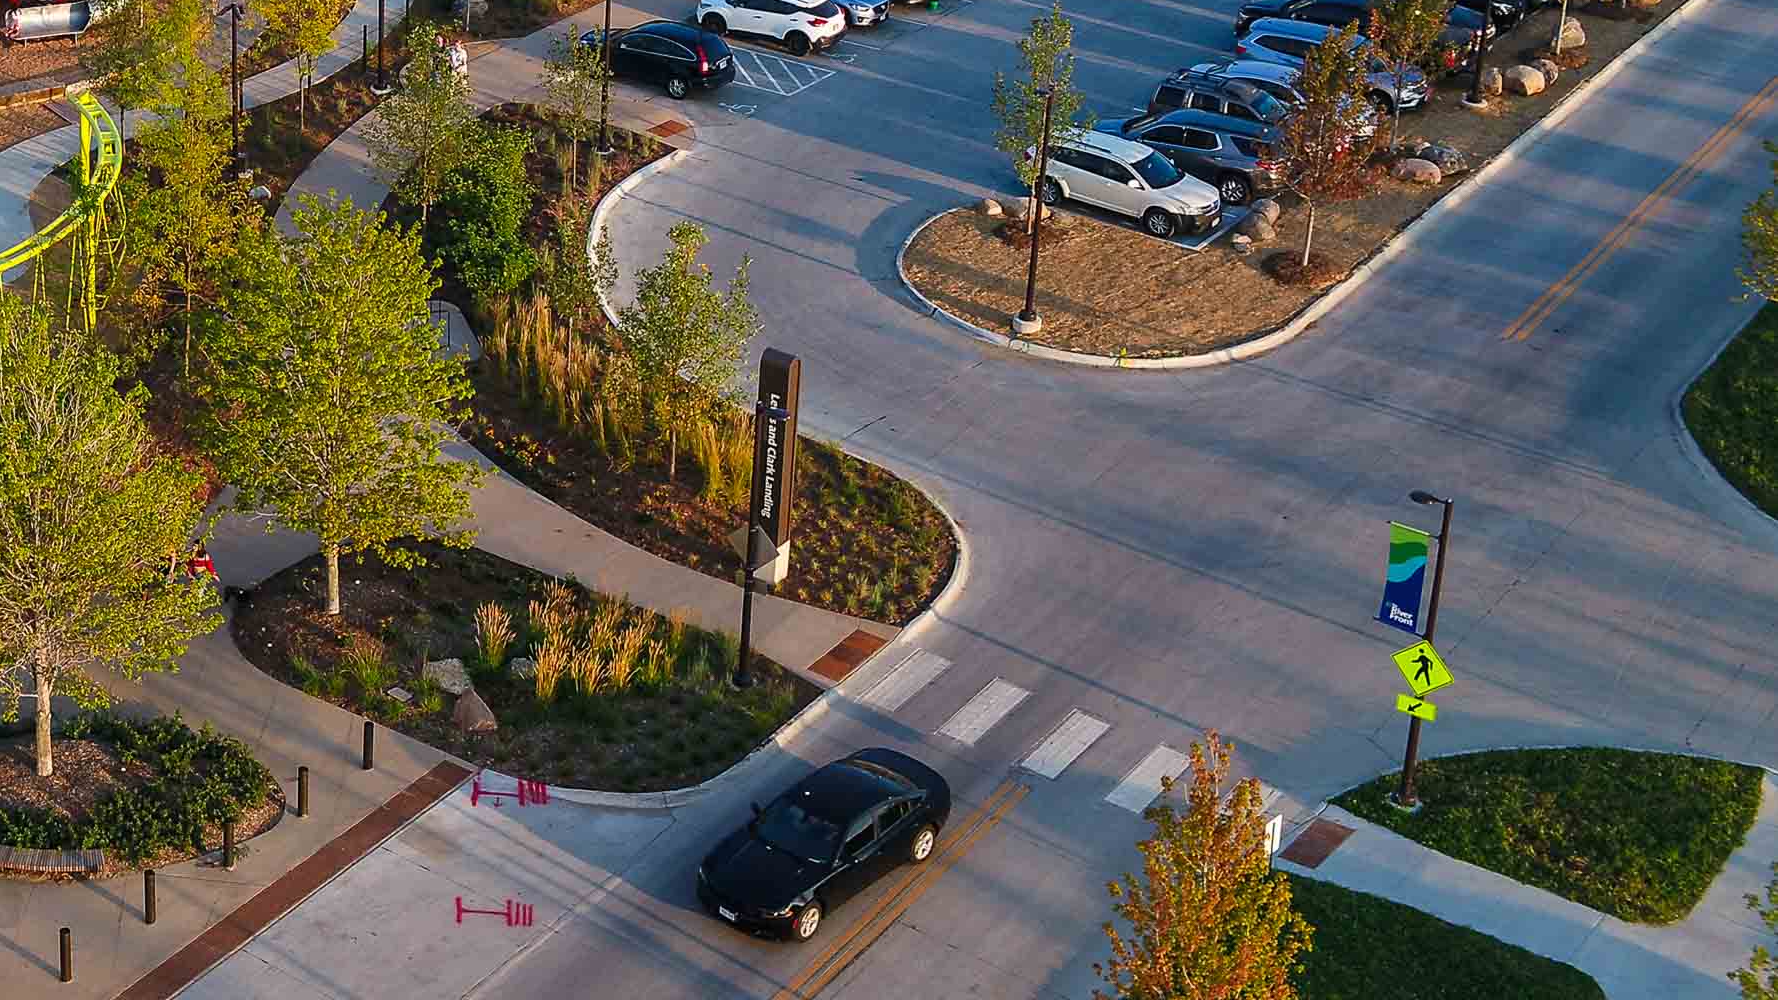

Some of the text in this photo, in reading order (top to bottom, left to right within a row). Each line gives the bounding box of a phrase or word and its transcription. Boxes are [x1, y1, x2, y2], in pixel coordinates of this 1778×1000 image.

[761, 393, 780, 518] Les and Clark Landing
[1390, 613, 1413, 626] Front
